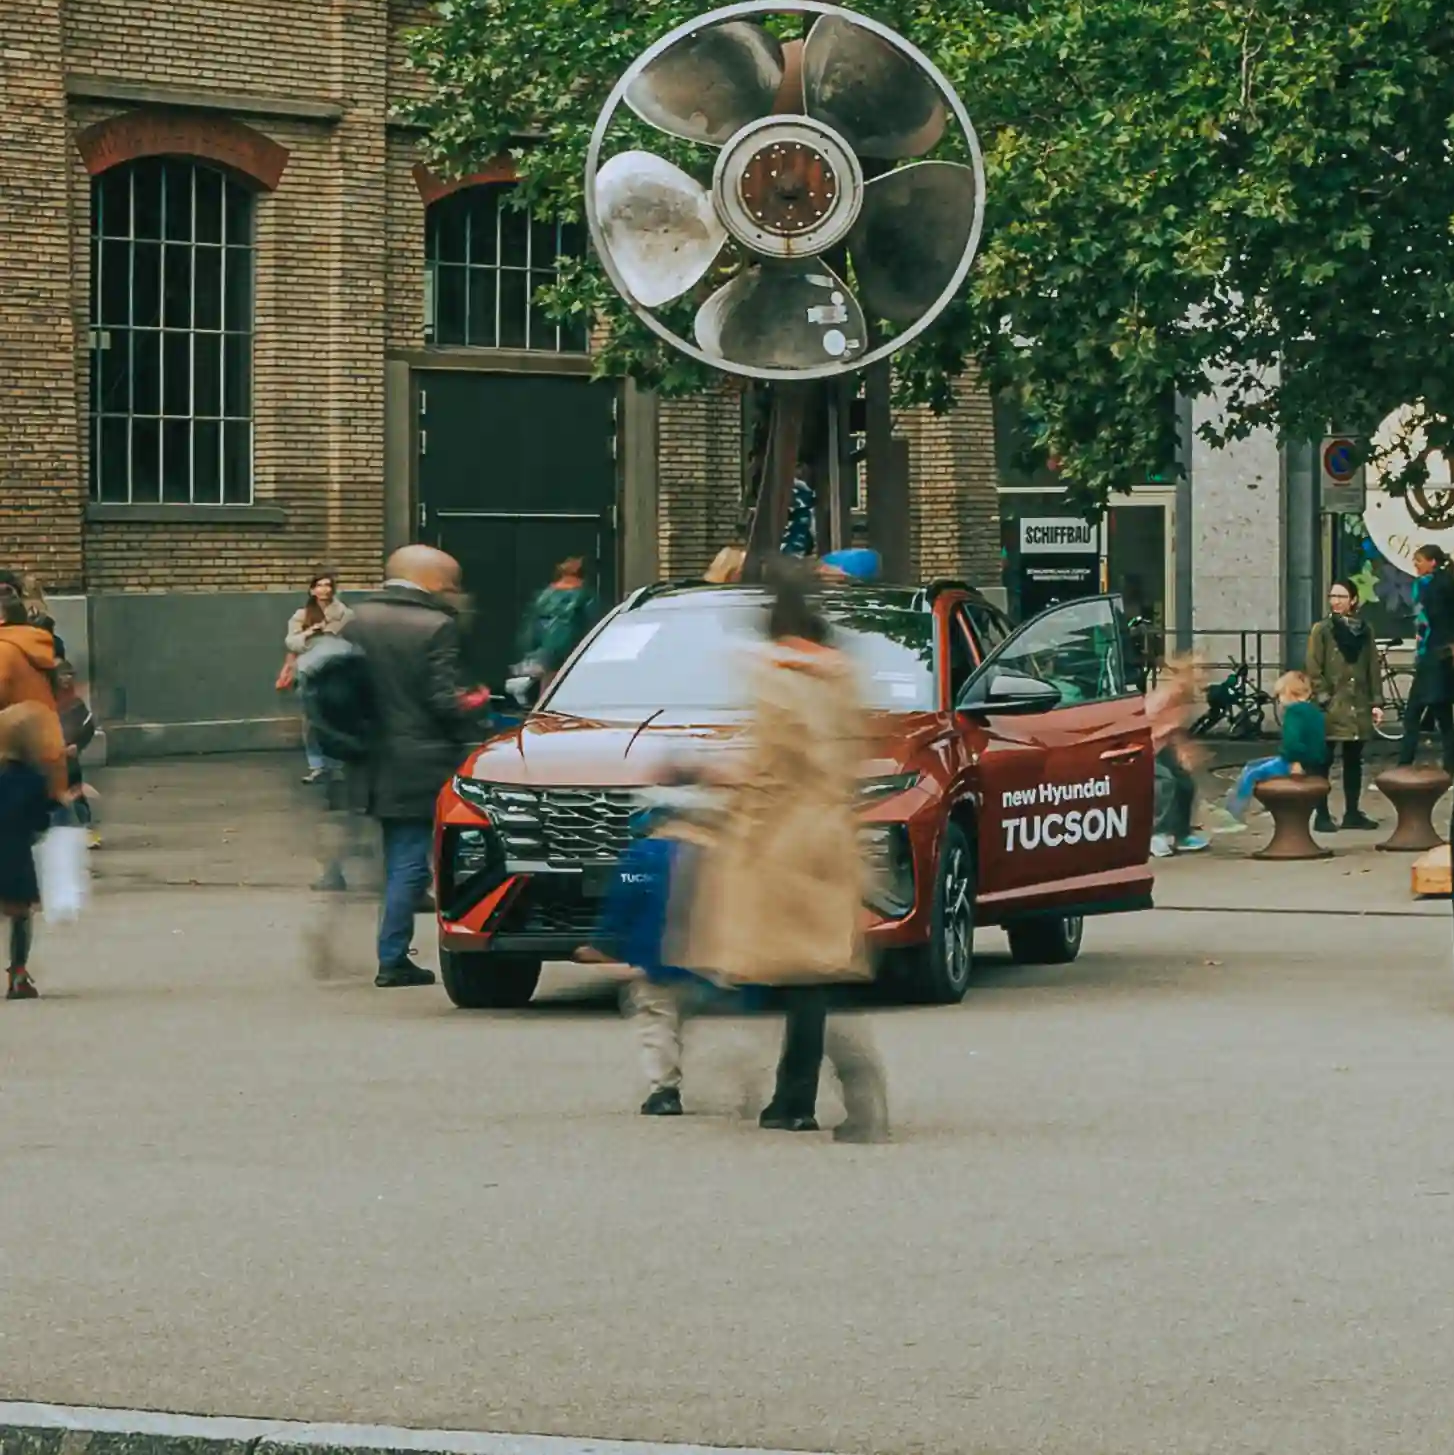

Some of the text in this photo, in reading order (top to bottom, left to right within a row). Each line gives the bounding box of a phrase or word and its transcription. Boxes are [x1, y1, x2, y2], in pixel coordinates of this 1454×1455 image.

[1025, 525, 1092, 544] SCHIFFBAU
[1002, 775, 1111, 808] new Hyundai
[1002, 804, 1129, 852] TUCSON
